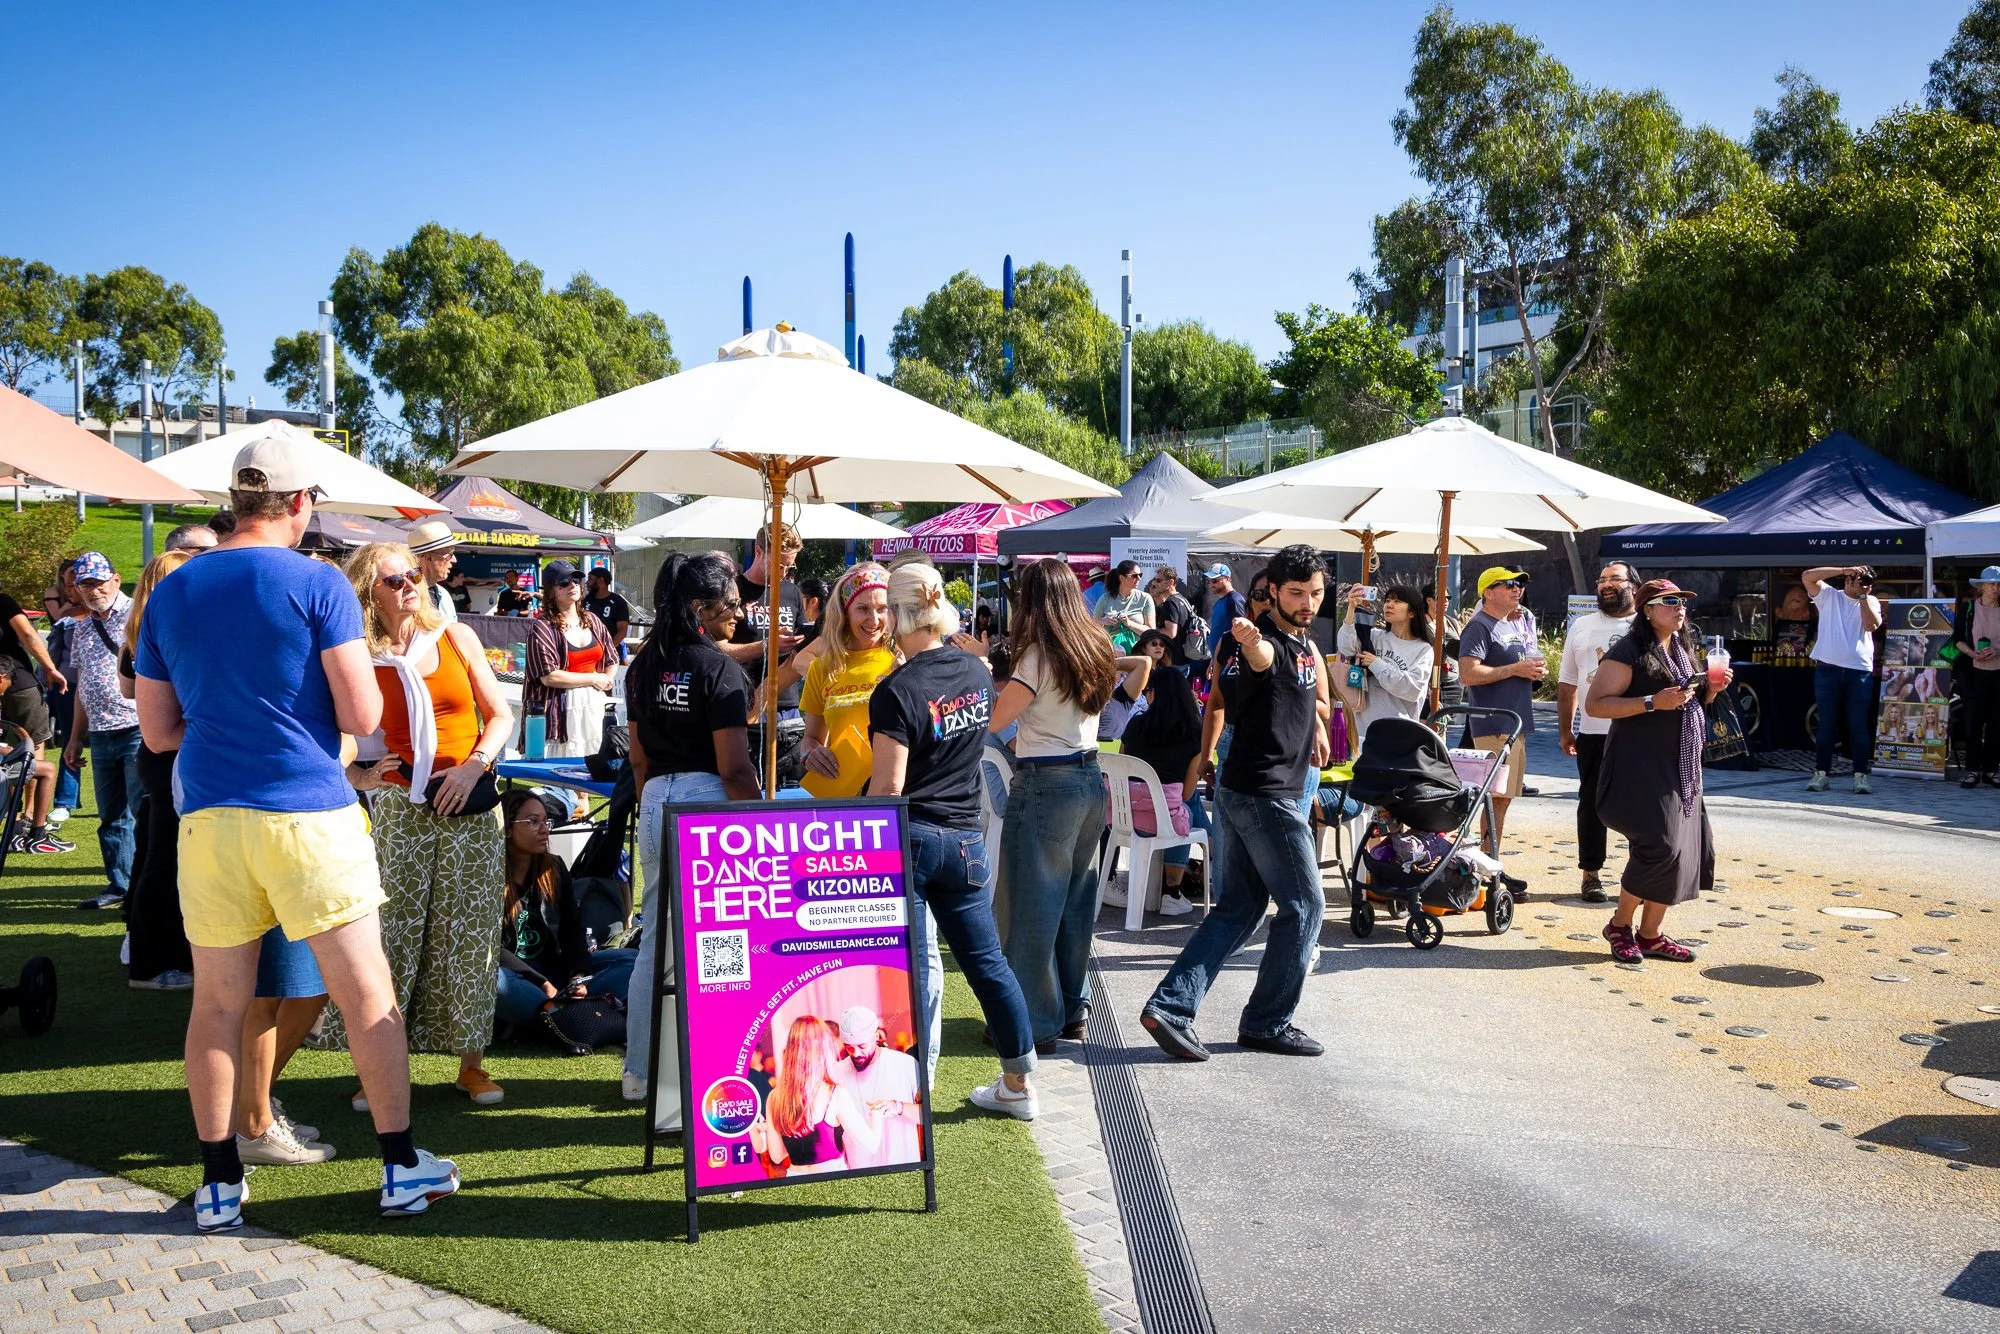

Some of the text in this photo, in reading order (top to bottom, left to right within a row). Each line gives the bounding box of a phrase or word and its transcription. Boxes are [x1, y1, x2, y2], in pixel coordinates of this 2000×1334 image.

[491, 532, 540, 547] BARBECUE
[881, 536, 964, 553] HENNA TATTOOS
[602, 606, 611, 618] 9
[755, 613, 793, 625] DACE
[944, 701, 989, 735] DANCE
[690, 819, 889, 857] TONIGHT
[691, 855, 790, 886] DANCE
[805, 854, 868, 873] SALSA
[807, 876, 895, 897] KIZOMBA
[693, 883, 794, 924] HERE
[809, 903, 897, 915] BEGINNER CLASSES
[822, 916, 858, 925] PARTNER
[859, 915, 897, 924] REQUIRED
[781, 936, 899, 953] DAVIDSMILEDANCE.COM
[700, 981, 751, 994] MORE INFO
[735, 1046, 749, 1075] MEET
[766, 991, 783, 1010] GET
[797, 964, 822, 984] HAVE
[823, 958, 843, 971] FUN
[719, 1100, 736, 1109] DAVID
[719, 1106, 754, 1118] DANCE
